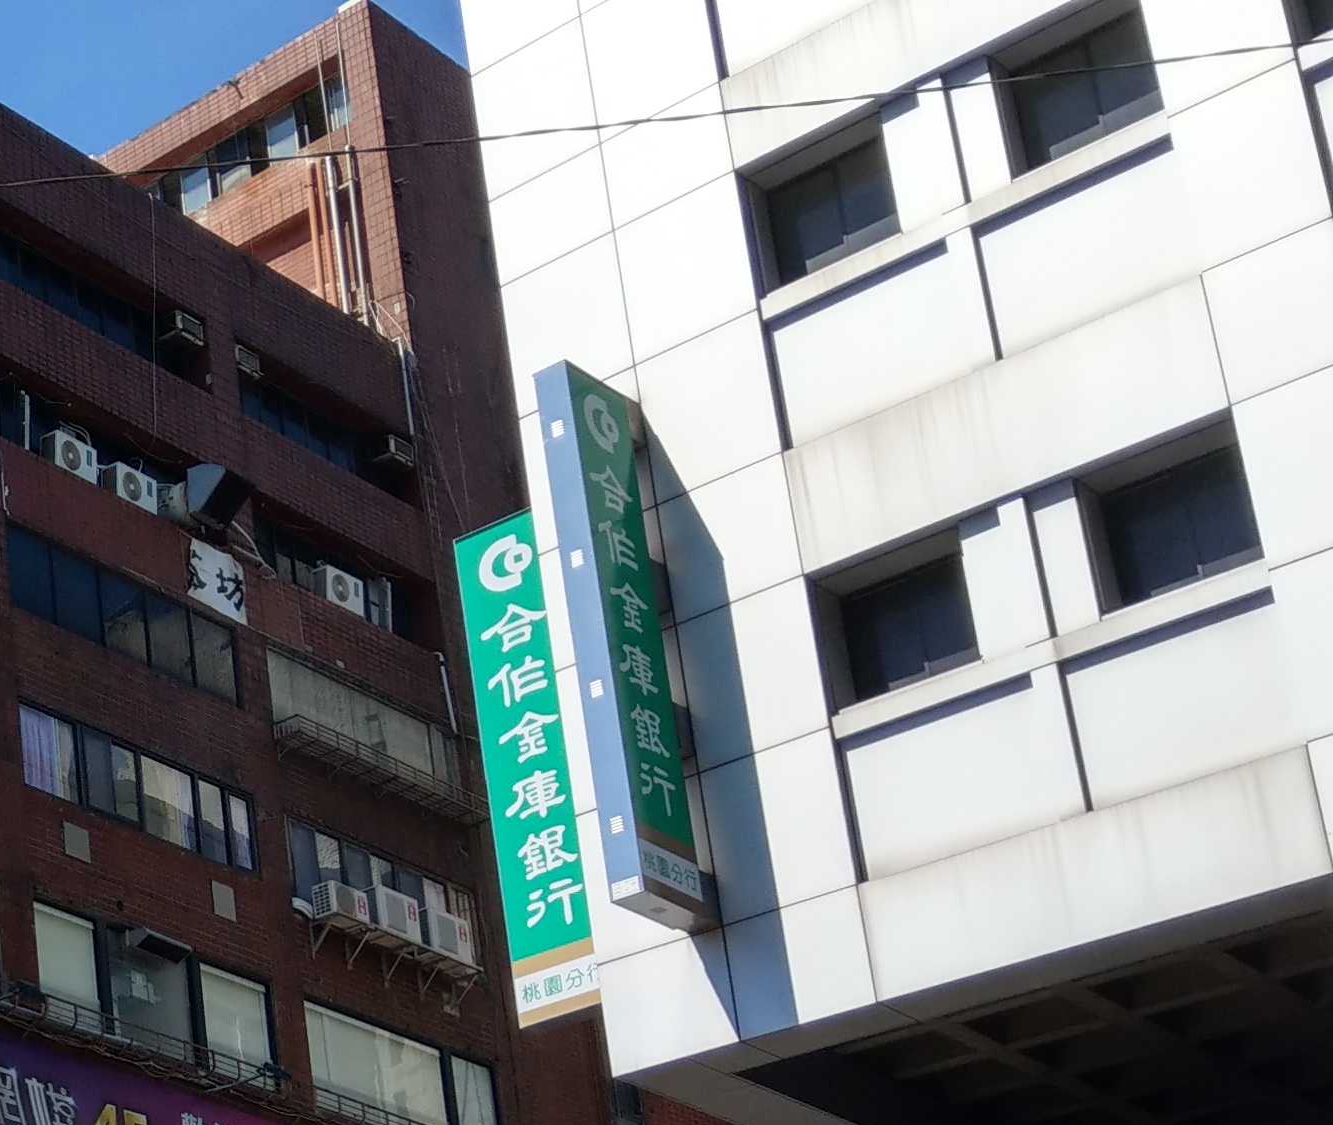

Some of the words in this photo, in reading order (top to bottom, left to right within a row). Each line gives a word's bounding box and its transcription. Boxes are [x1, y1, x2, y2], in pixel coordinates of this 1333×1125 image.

[481, 603, 585, 928] 合作金庫銀行
[589, 465, 676, 815] 合作金庫銀行
[643, 852, 698, 892] 桃園分行
